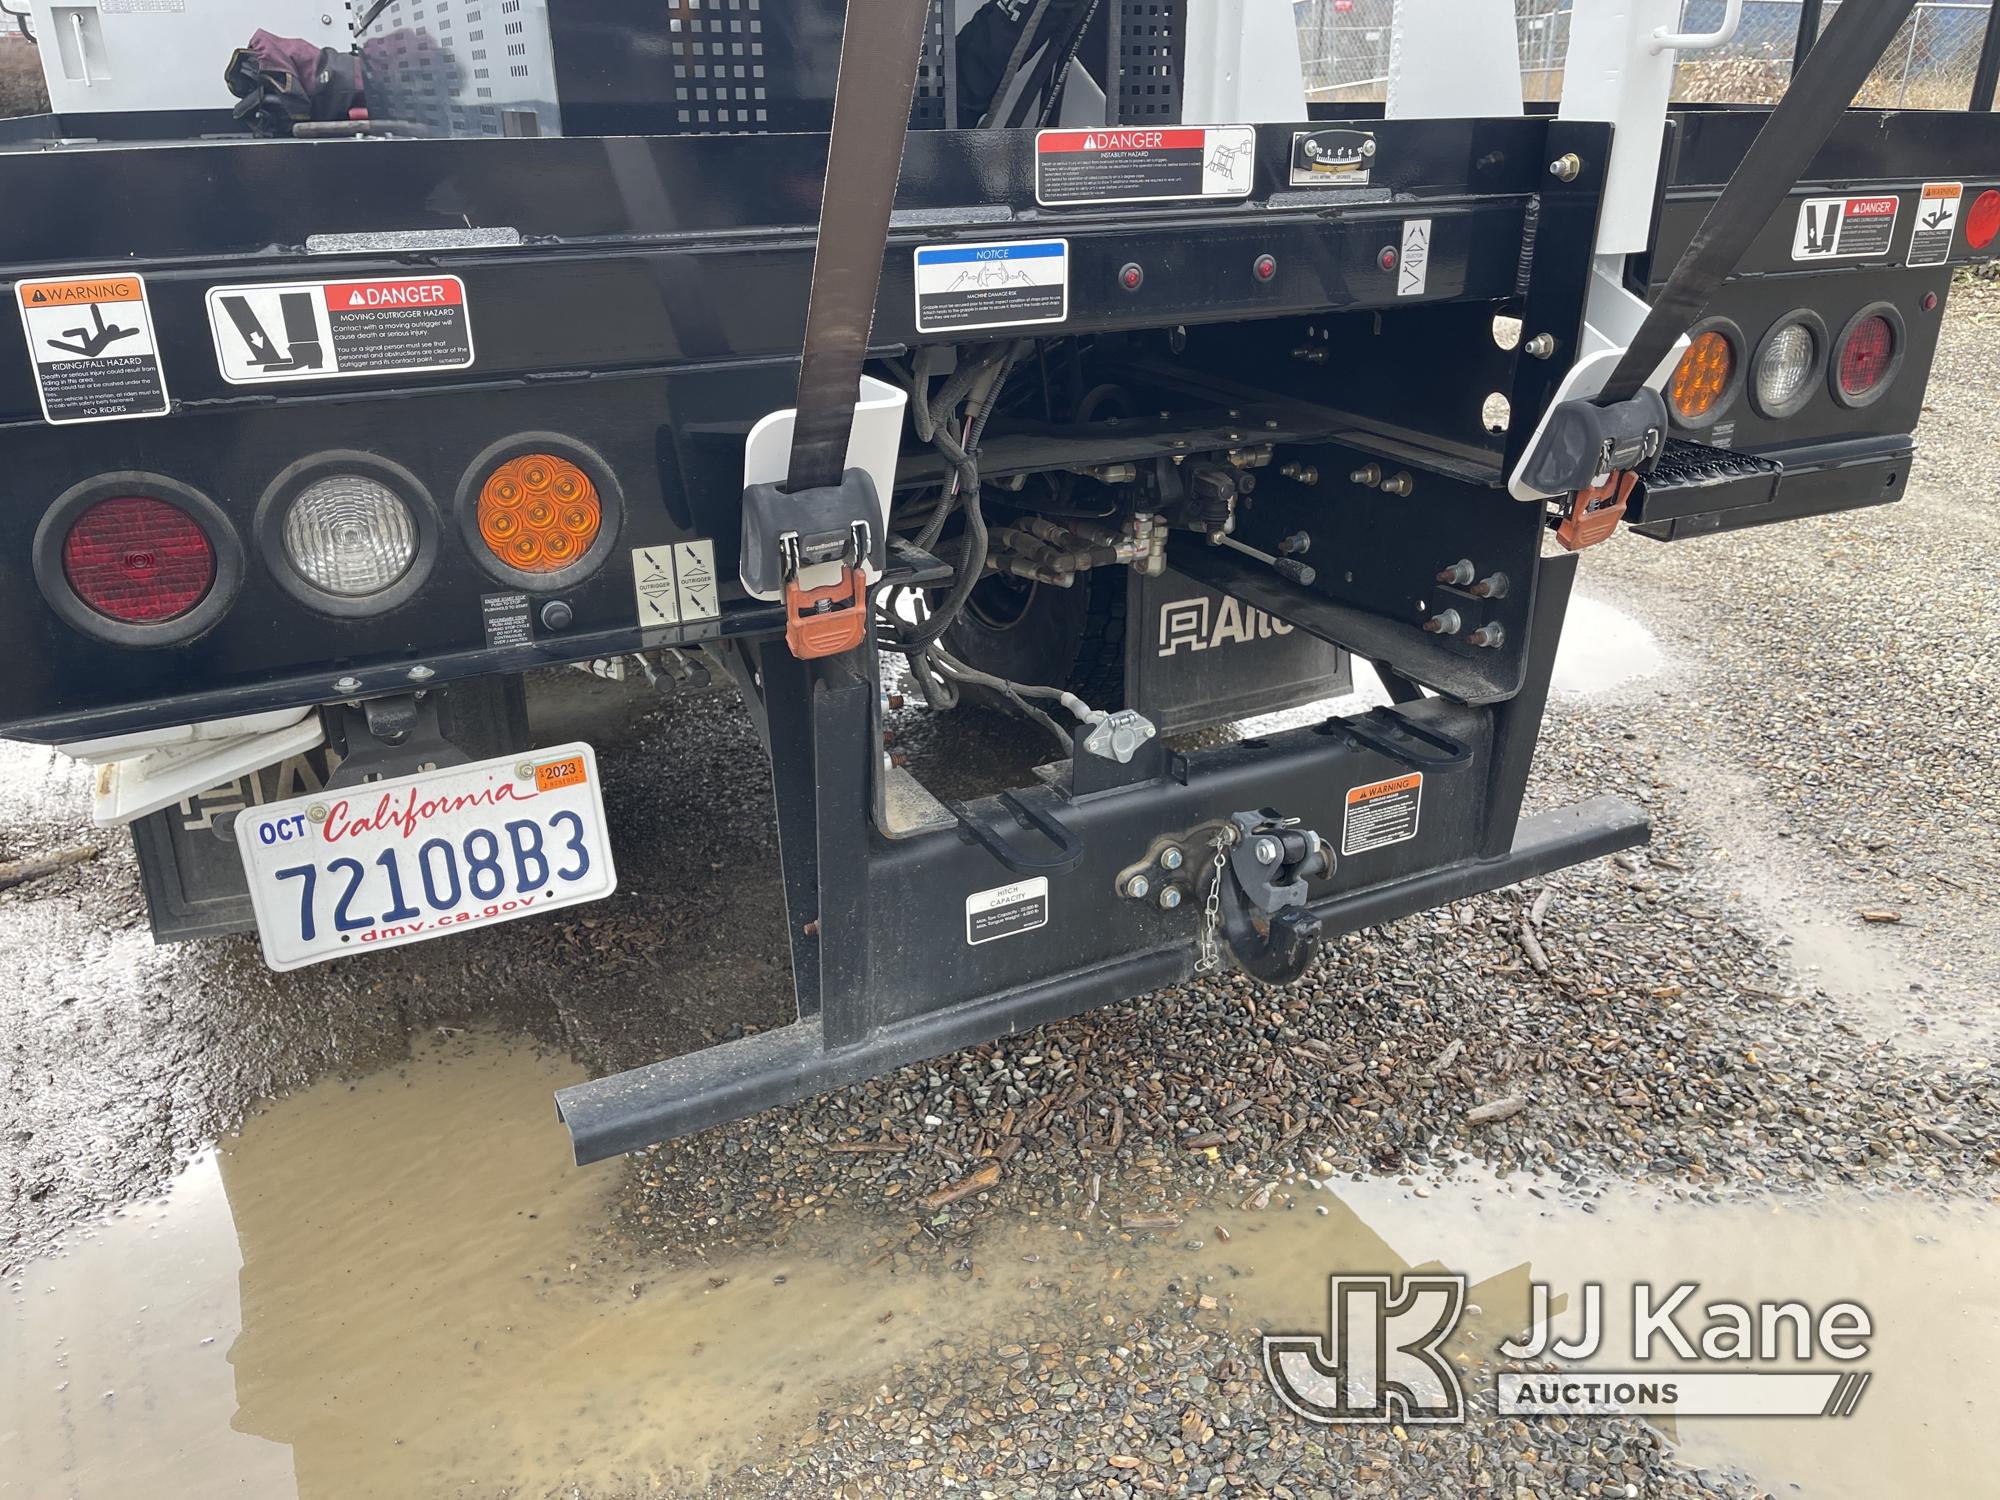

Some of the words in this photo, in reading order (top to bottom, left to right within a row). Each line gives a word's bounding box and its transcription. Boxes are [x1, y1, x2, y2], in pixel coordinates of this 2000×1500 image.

[1097, 132, 1163, 149] DANGER
[1932, 187, 1958, 196] WARNING
[1860, 202, 1891, 213] DANGER
[976, 250, 1010, 260] NOTICE
[46, 284, 129, 300] WARNING
[366, 285, 446, 305] DANGER
[340, 314, 376, 322] MOVING
[376, 311, 422, 320] OUTRIGGER
[422, 308, 454, 317] HAZARD
[332, 324, 362, 332] Contact
[411, 320, 441, 328] outrigger
[338, 352, 370, 361] personnel
[52, 360, 106, 370] RIDING/FALL
[106, 358, 142, 366] HAZARD
[84, 407, 98, 415] NO
[100, 406, 126, 414] RIDERS
[681, 576, 712, 584] OUTRIGGER
[640, 582, 670, 591] OUTRIGGER
[546, 762, 576, 780] 2023
[1369, 780, 1409, 796] WARNING
[259, 814, 305, 845] OCT
[323, 775, 540, 843] California
[274, 810, 590, 942] 72108B3
[998, 887, 1018, 896] HITCH
[990, 893, 1025, 906] CAPACITY
[360, 896, 535, 942] dmv.ca.gov
